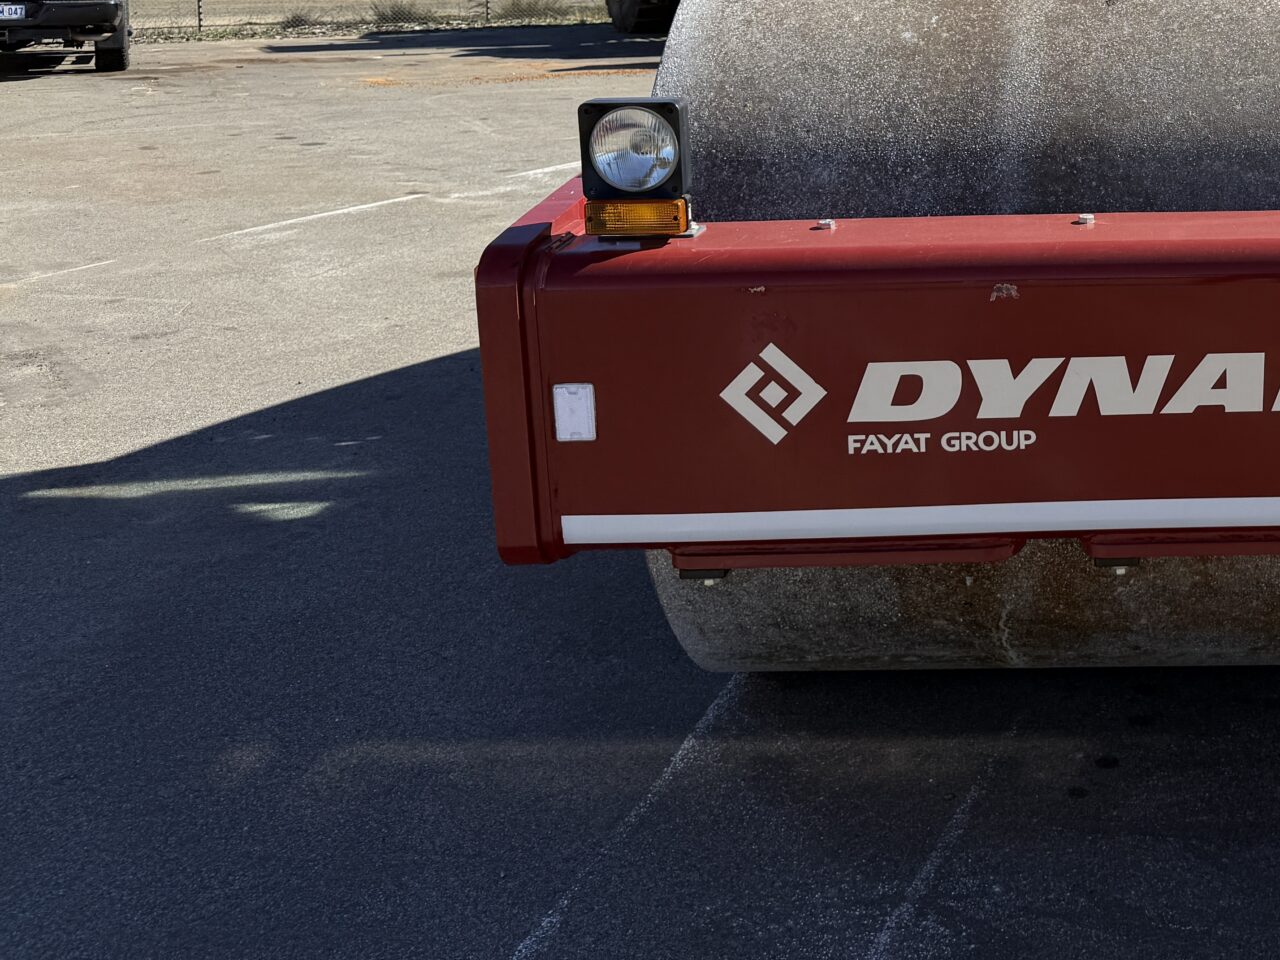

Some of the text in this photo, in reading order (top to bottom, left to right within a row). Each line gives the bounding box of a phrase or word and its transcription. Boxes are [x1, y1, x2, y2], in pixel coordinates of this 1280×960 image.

[8, 7, 24, 16] 047
[847, 429, 1037, 454] FAYAT GROUP
